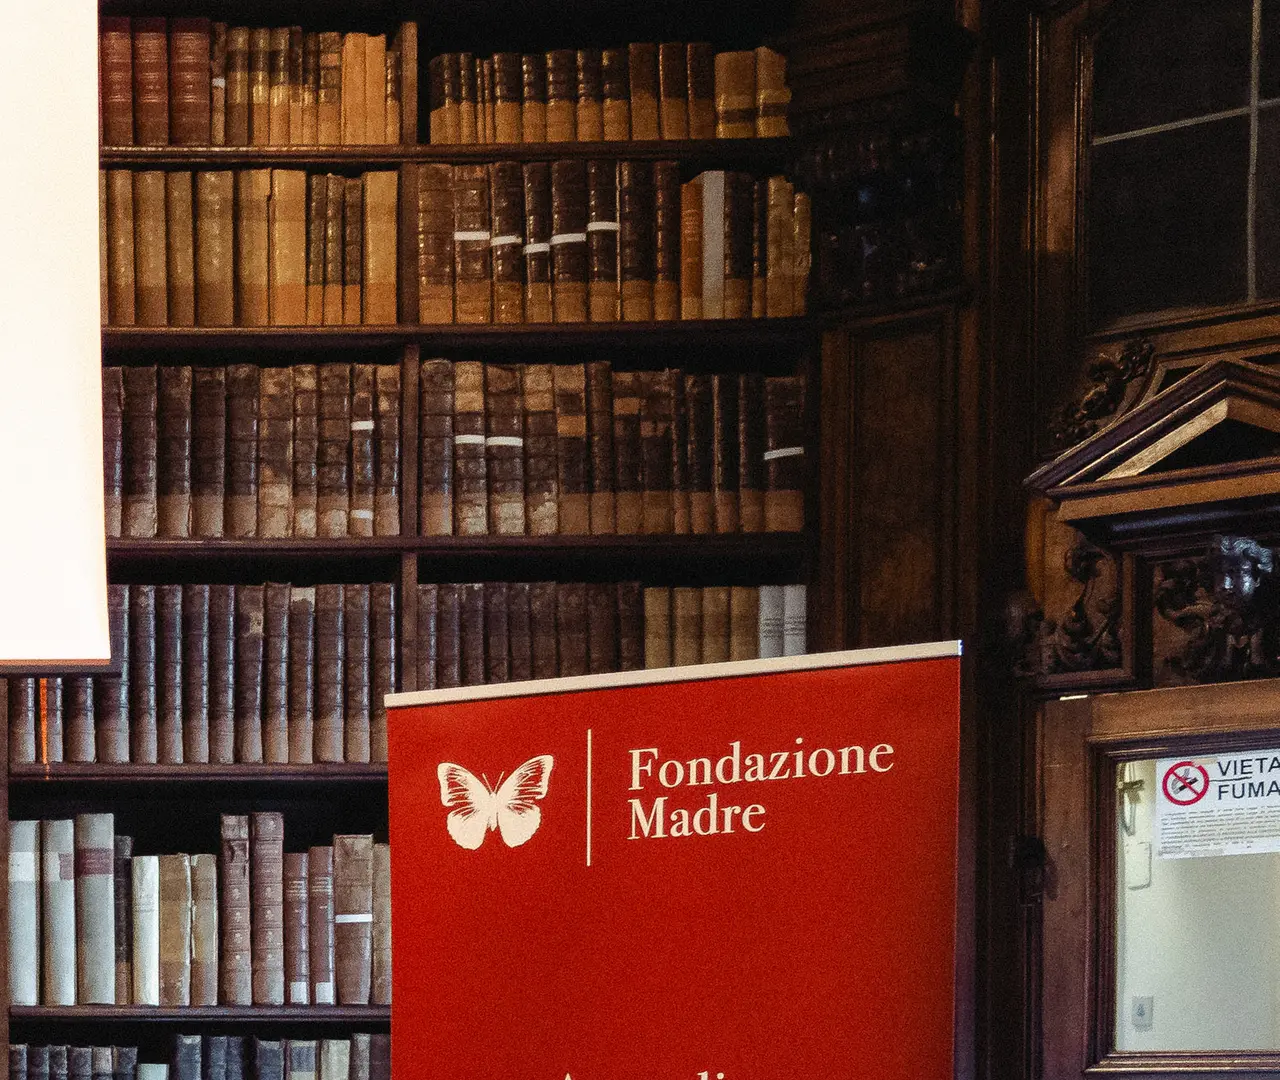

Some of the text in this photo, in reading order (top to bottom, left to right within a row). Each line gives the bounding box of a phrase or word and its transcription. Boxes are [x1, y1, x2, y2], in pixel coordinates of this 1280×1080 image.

[628, 737, 895, 790] Fondazione
[1217, 756, 1280, 776] VIETA
[1218, 780, 1280, 800] FUMA
[627, 793, 766, 840] Madre
